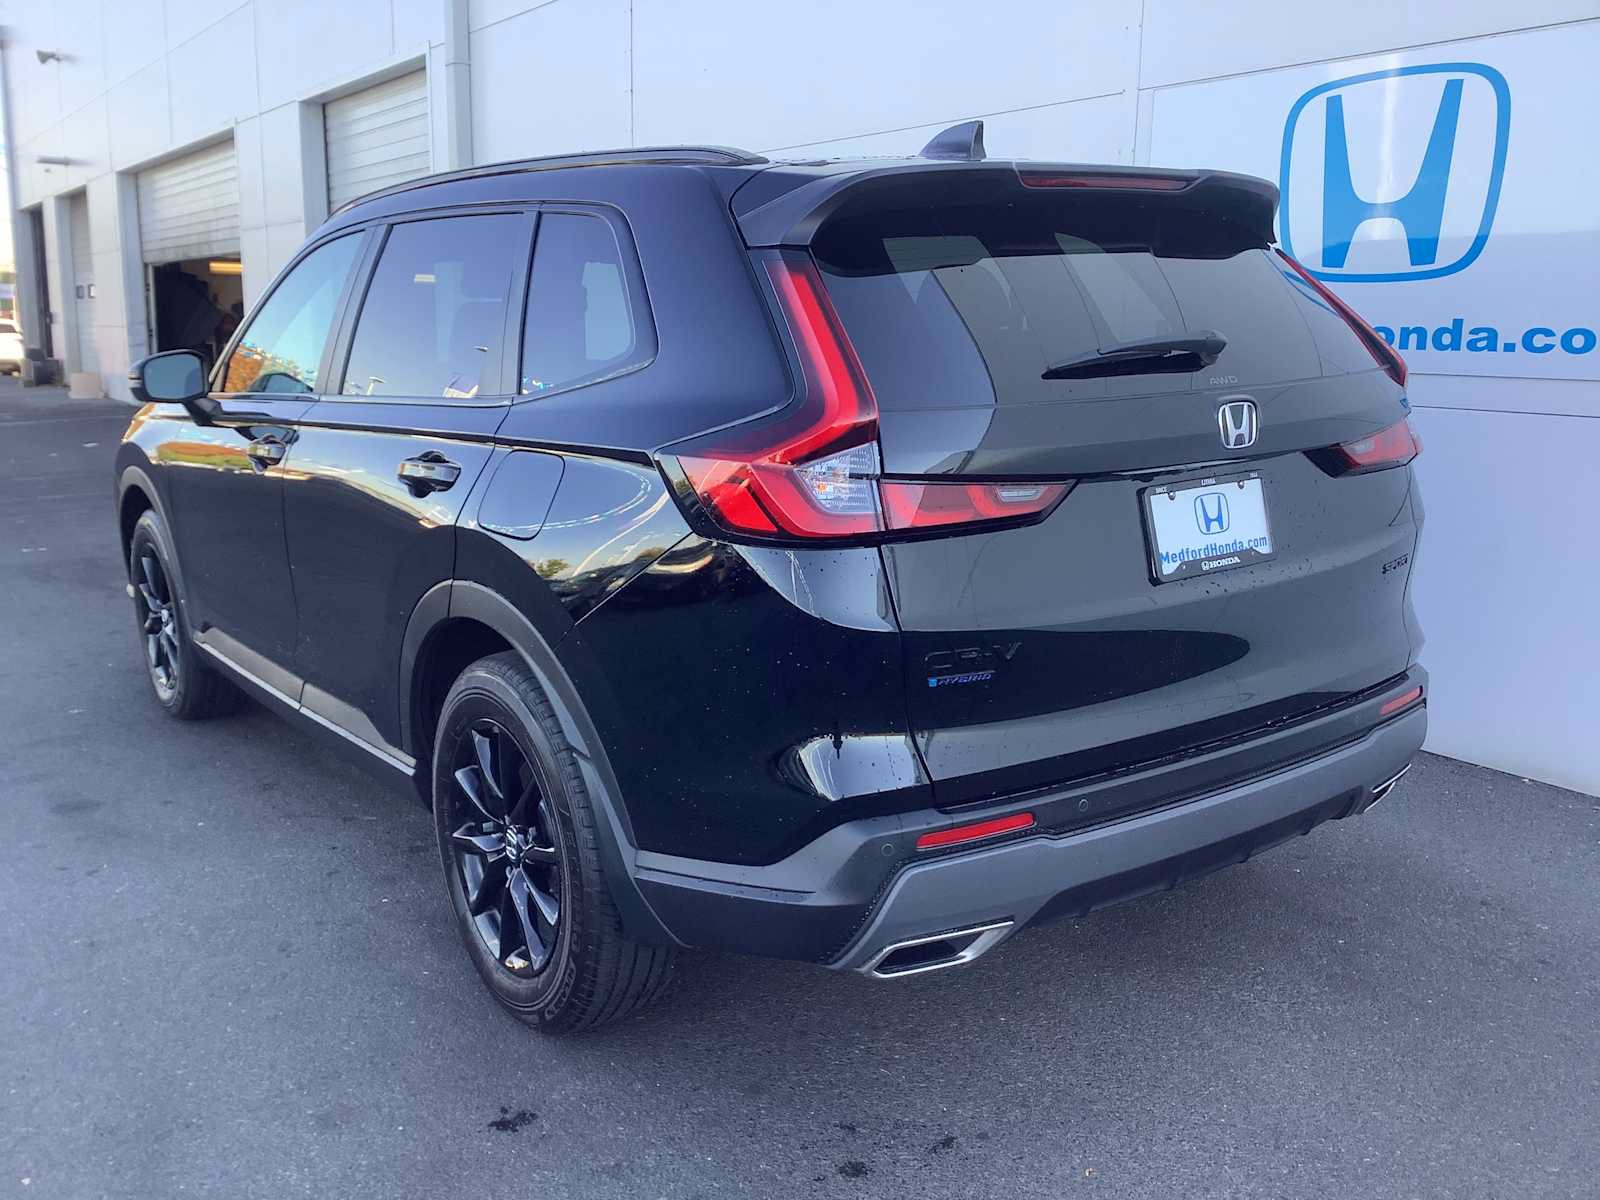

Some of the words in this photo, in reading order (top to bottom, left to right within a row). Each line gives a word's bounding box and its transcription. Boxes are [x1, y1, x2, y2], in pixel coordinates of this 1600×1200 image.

[1209, 375, 1239, 385] AWD
[1158, 536, 1268, 564] MedfordHonda.com
[1209, 556, 1241, 569] HONDA
